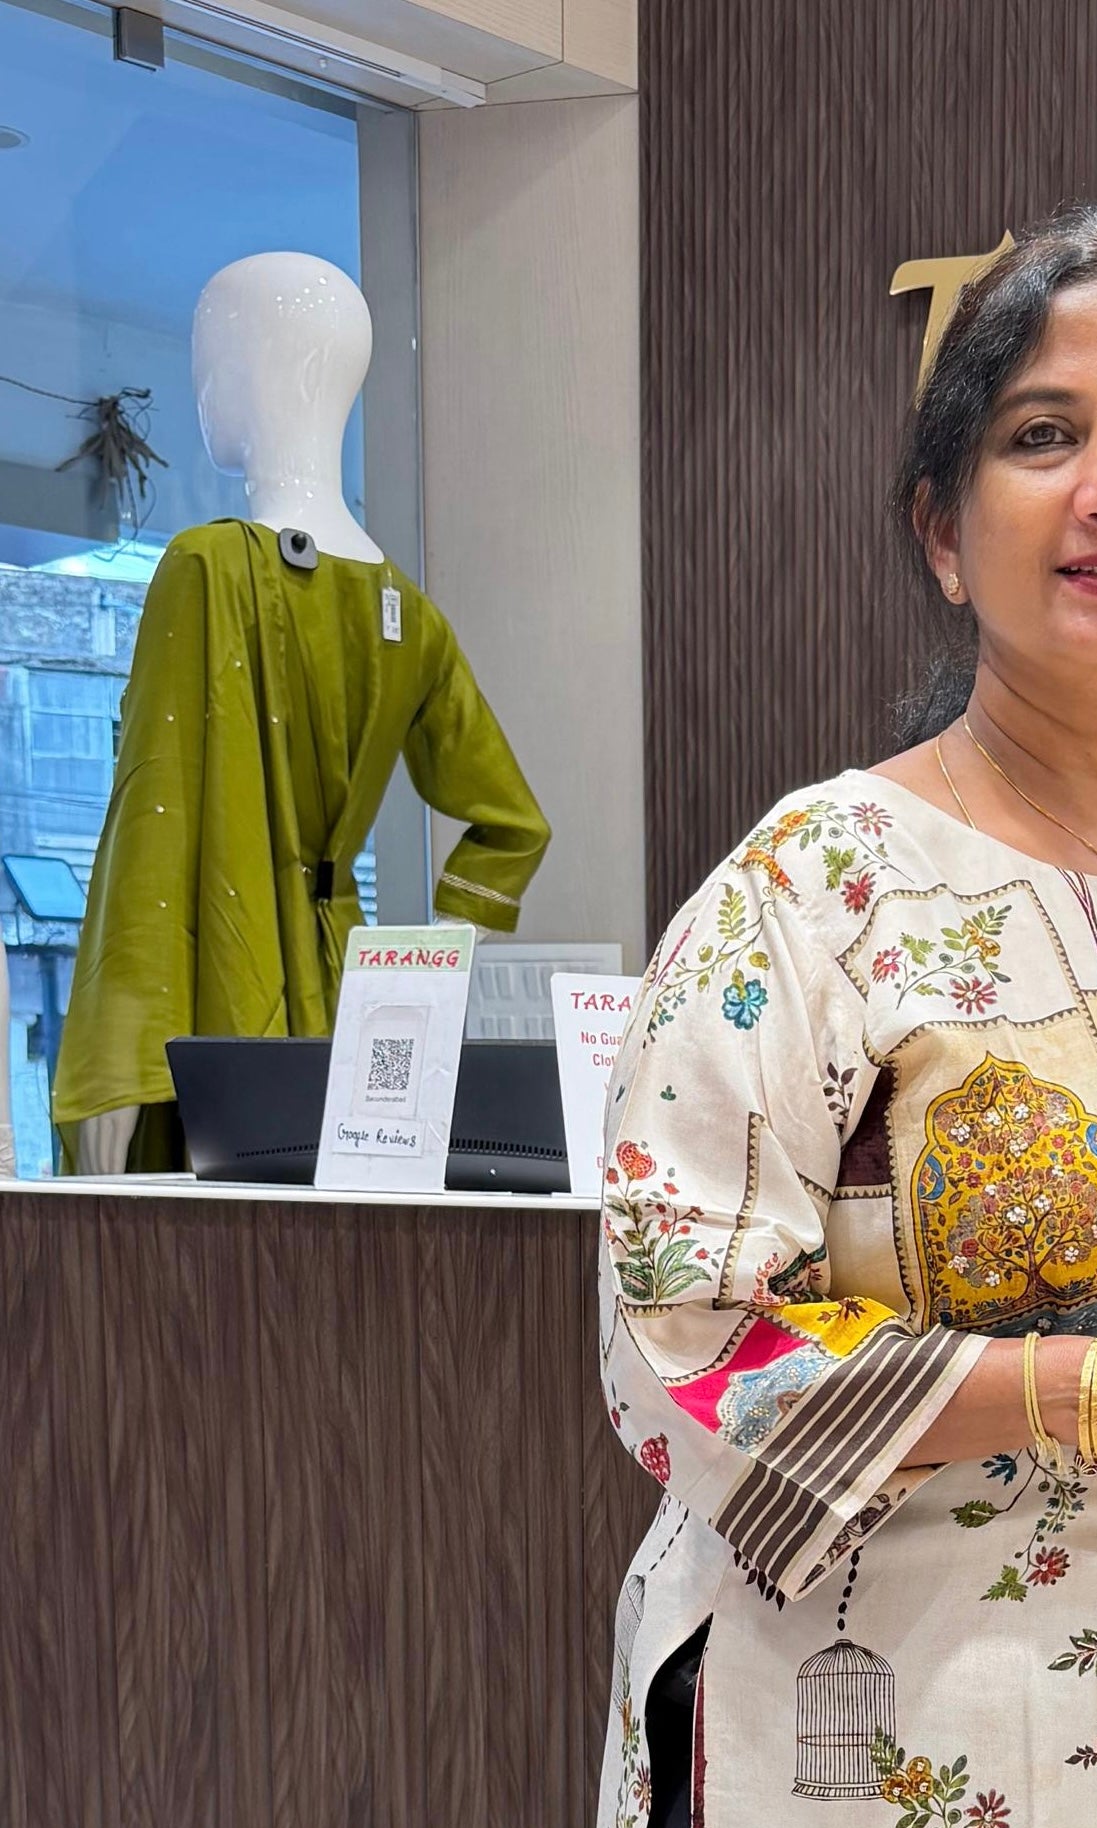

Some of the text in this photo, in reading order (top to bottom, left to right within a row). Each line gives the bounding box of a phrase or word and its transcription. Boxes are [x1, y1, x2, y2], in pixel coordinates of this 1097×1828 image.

[359, 948, 461, 968] TARANGG
[570, 991, 631, 1012] TARA
[581, 1031, 623, 1046] No Gua
[375, 1128, 416, 1148] Reviews
